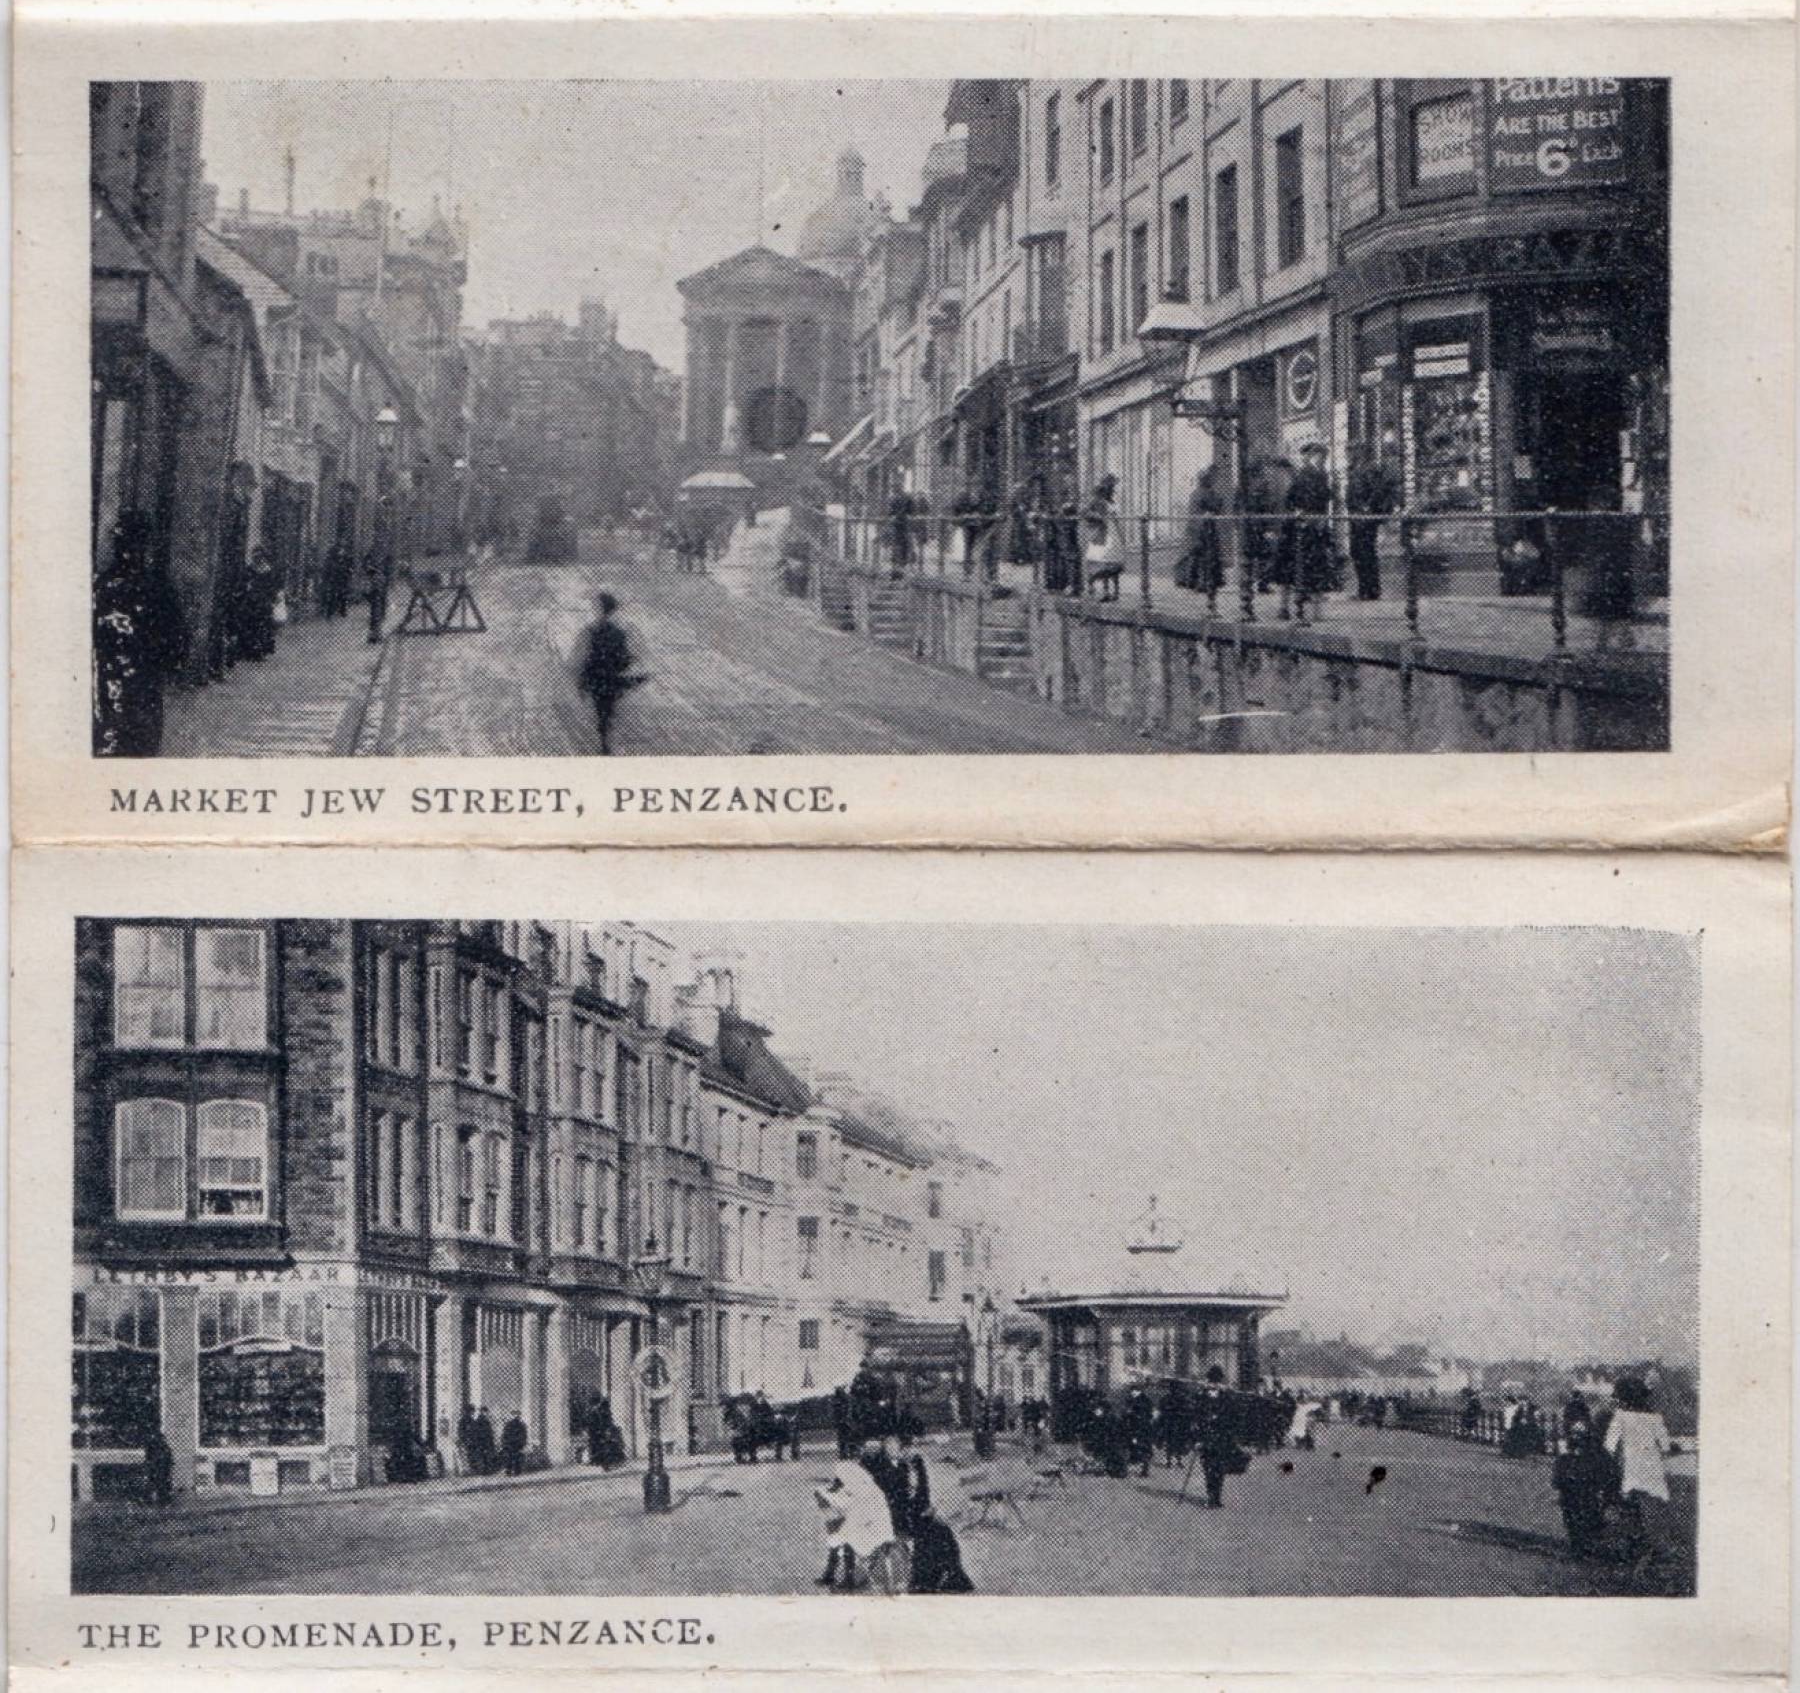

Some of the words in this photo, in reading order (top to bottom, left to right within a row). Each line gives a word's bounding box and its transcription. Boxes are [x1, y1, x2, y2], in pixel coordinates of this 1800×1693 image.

[1572, 108, 1620, 130] BEST
[109, 787, 279, 815] MARKET
[300, 787, 386, 819] JEW
[411, 787, 586, 818] STREET,
[613, 785, 849, 814] PENZANCE.
[77, 1622, 163, 1649] THE
[188, 1622, 458, 1651] PROMENADE,
[484, 1618, 717, 1647] PENZANCE.
